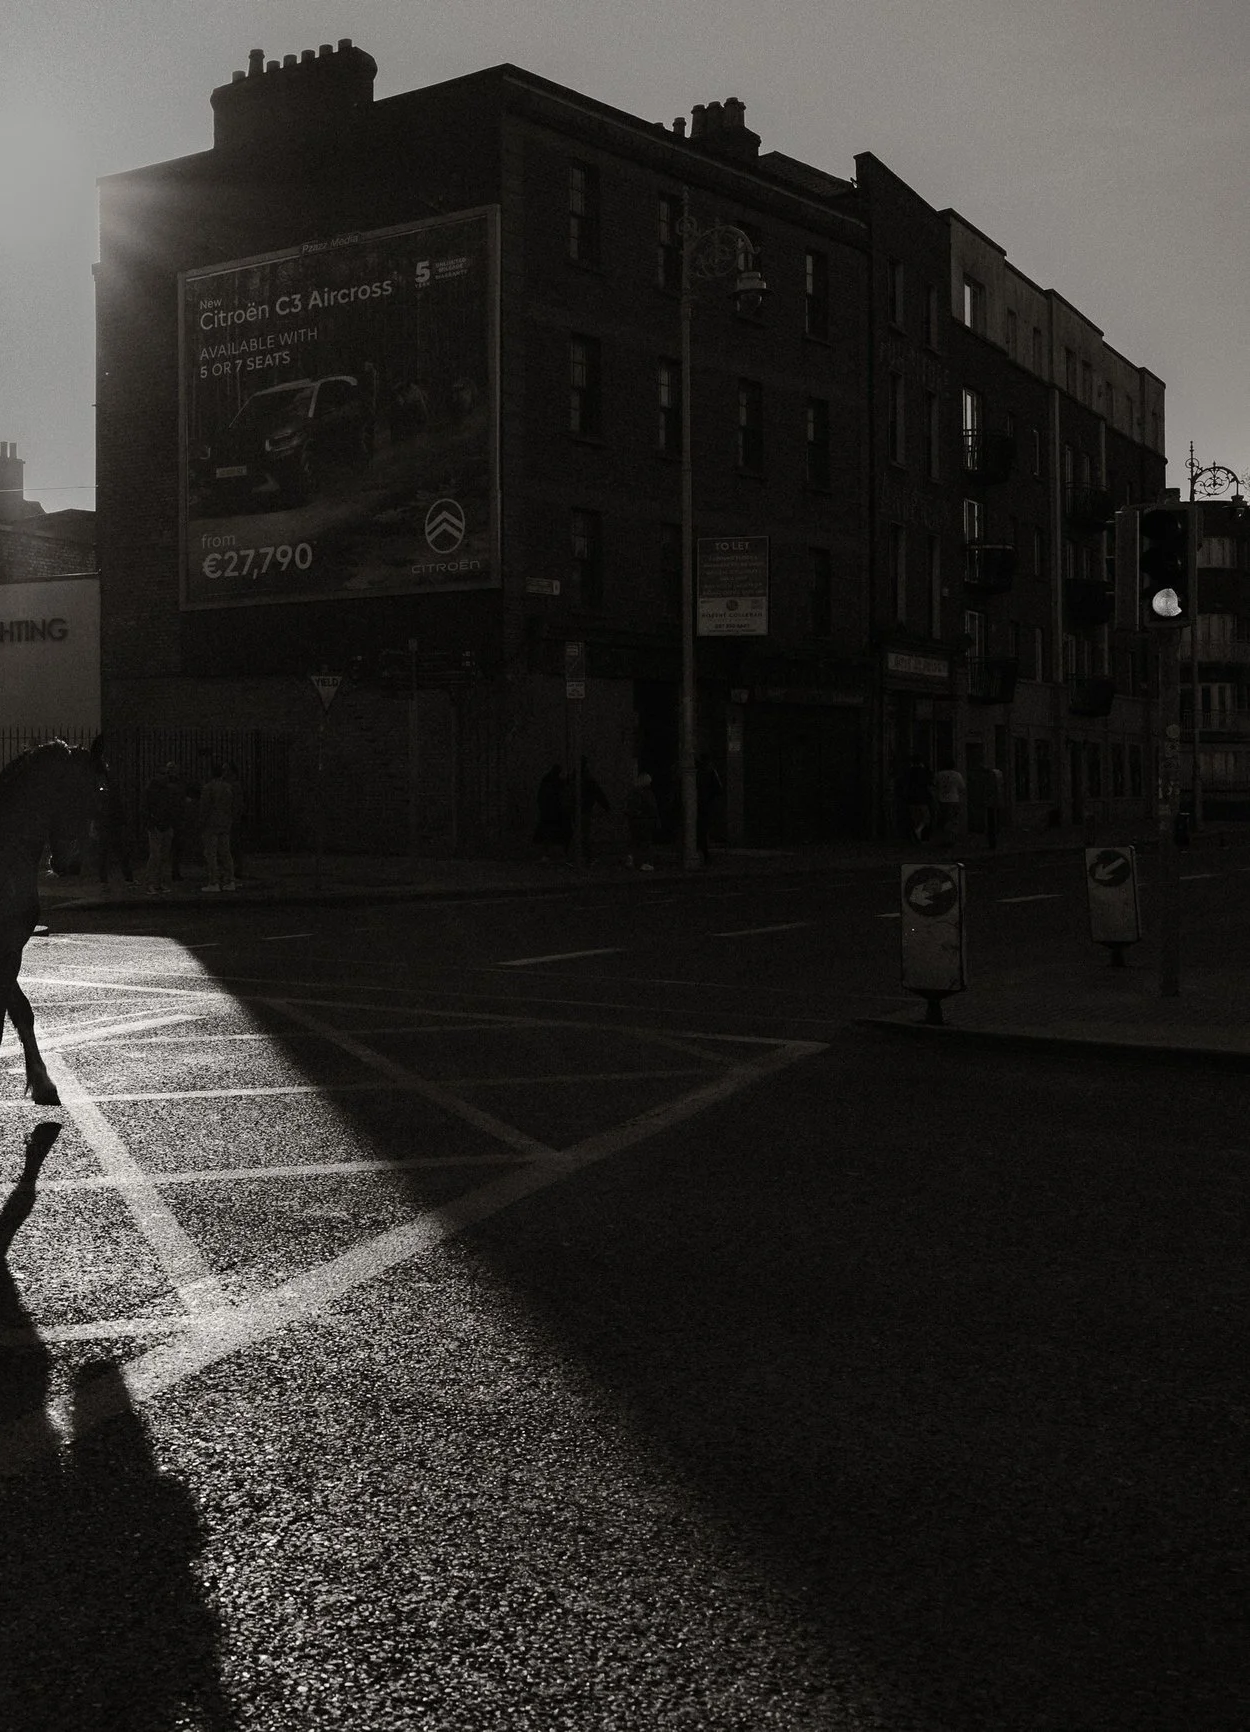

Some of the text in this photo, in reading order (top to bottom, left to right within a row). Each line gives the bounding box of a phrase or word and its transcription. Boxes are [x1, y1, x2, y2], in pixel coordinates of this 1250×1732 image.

[414, 260, 430, 283] 5
[200, 299, 222, 310] New
[200, 280, 392, 330] Citroën C3 Aircross
[199, 327, 317, 360] AVAILABLE WITH
[200, 351, 290, 378] 5 OR 7 SEATS
[201, 534, 235, 548] from
[715, 541, 750, 551] TO LET
[315, 678, 338, 687] YIELD
